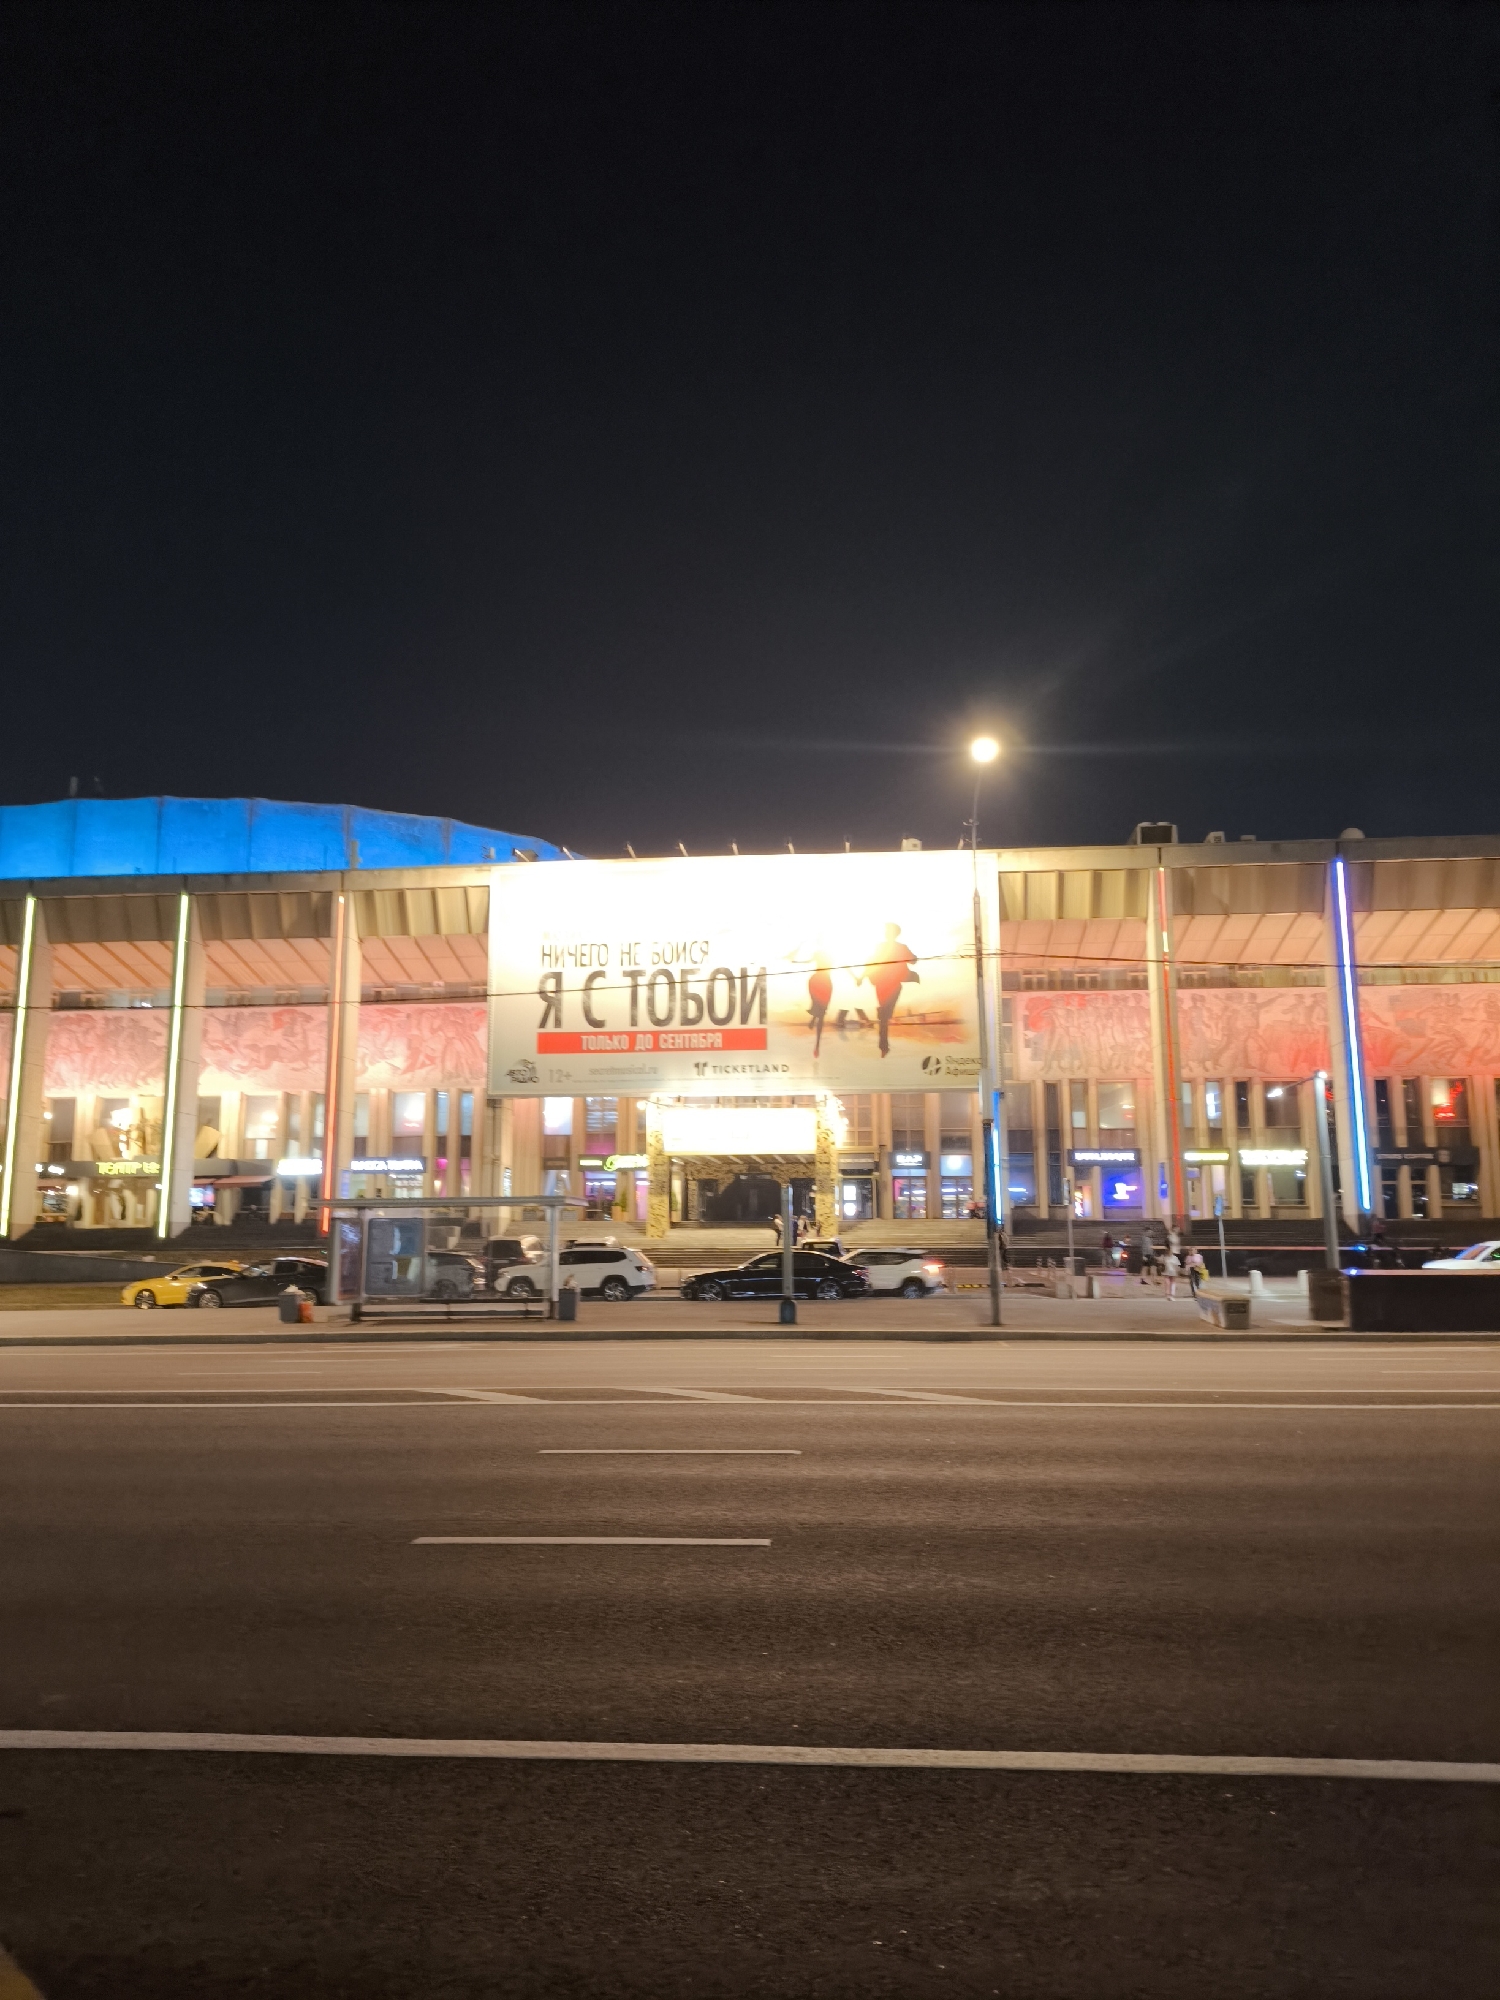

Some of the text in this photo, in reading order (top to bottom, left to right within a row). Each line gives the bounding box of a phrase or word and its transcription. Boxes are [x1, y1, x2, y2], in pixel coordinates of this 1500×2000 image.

[541, 943, 609, 968] НИЧЕГО
[620, 942, 641, 967] НЕ
[538, 971, 564, 1029] Я
[582, 970, 607, 1029] С
[580, 1033, 723, 1052] ТОЛЬКО ДО СЕНТЯБРЯ
[548, 1068, 573, 1083] 12+
[711, 1063, 790, 1074] TICKETLAND
